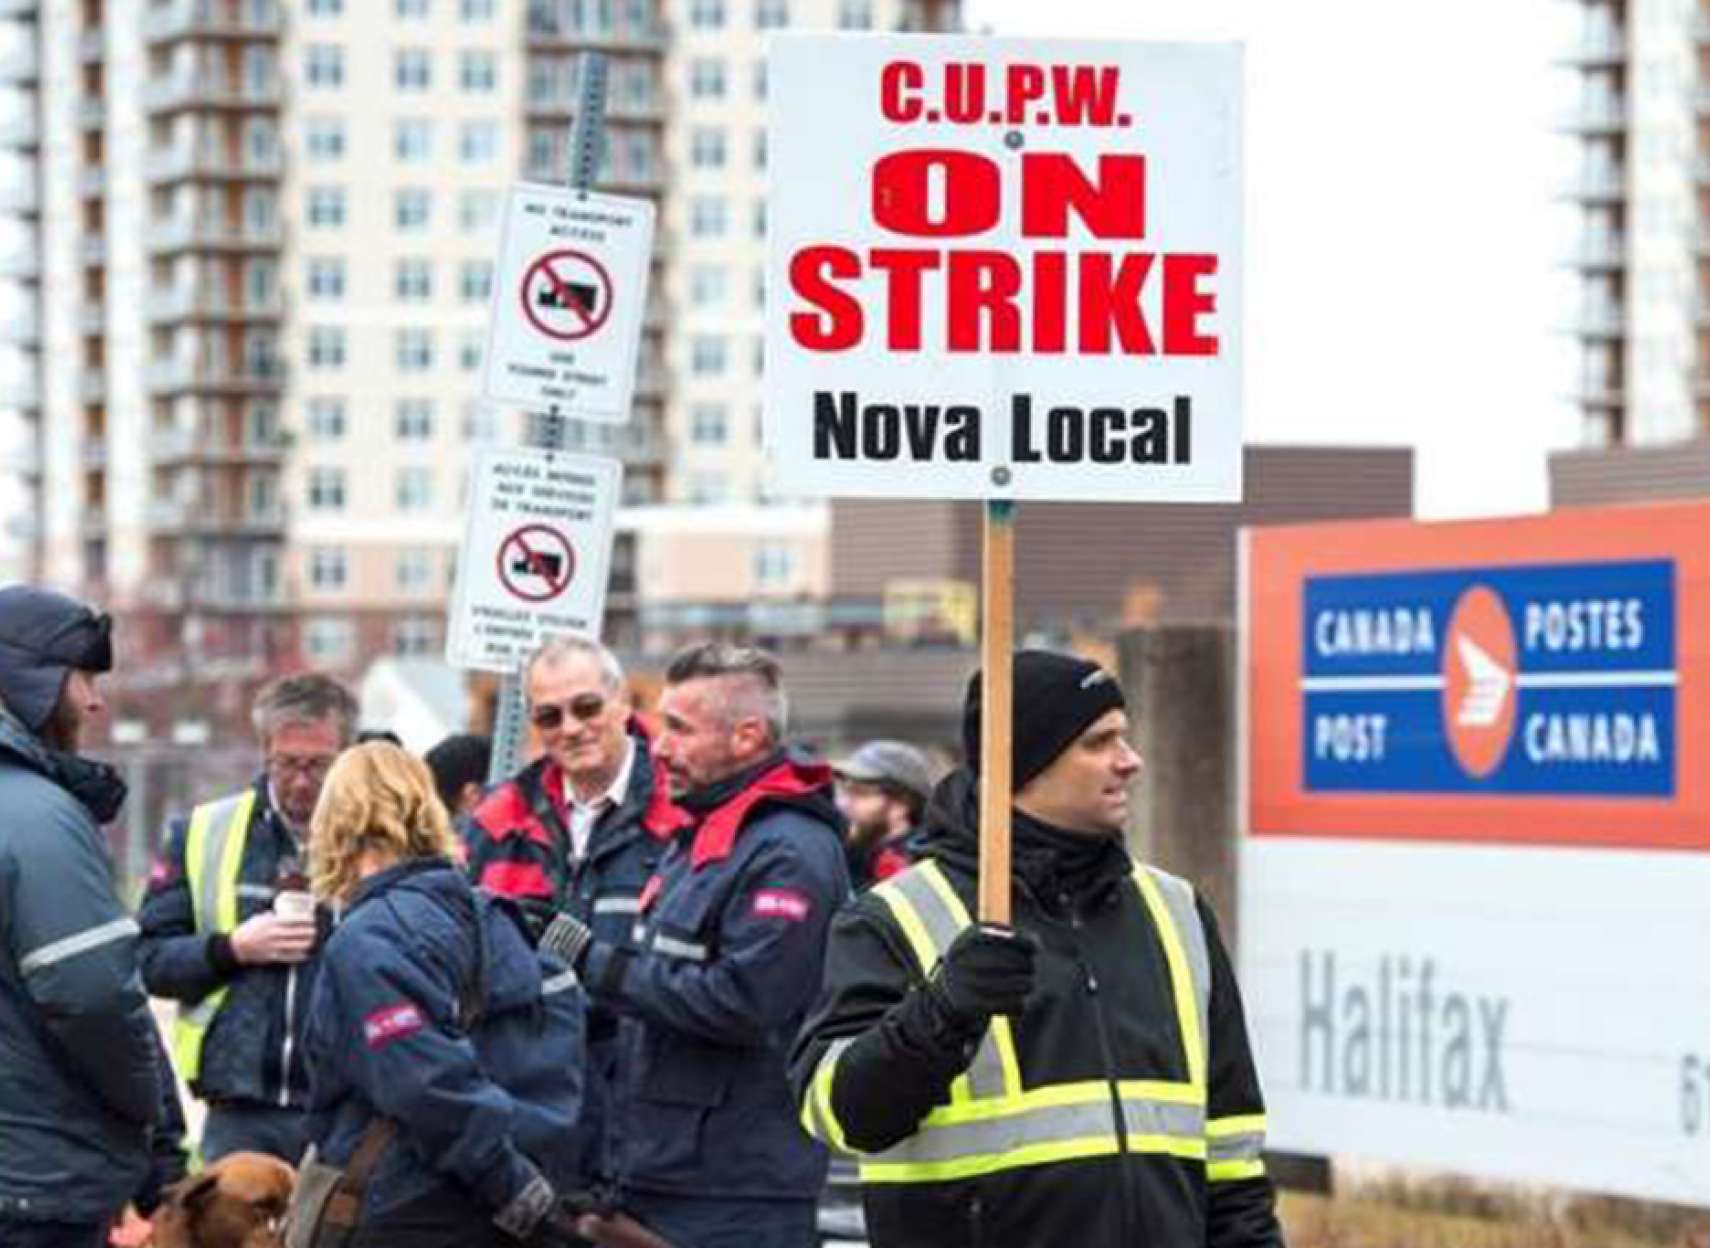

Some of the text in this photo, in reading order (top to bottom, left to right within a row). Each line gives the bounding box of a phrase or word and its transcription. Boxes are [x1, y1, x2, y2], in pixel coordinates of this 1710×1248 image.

[881, 61, 1131, 126] C.U.P.W.
[872, 148, 1146, 240] ON
[788, 245, 1219, 356] STRIKE
[813, 391, 1192, 465] Nova Local
[1314, 608, 1435, 656] CANADA
[1524, 600, 1644, 650] POSTES
[1314, 713, 1388, 761] POST
[1524, 713, 1660, 763] CANADA
[1299, 948, 1509, 1113] Halifax
